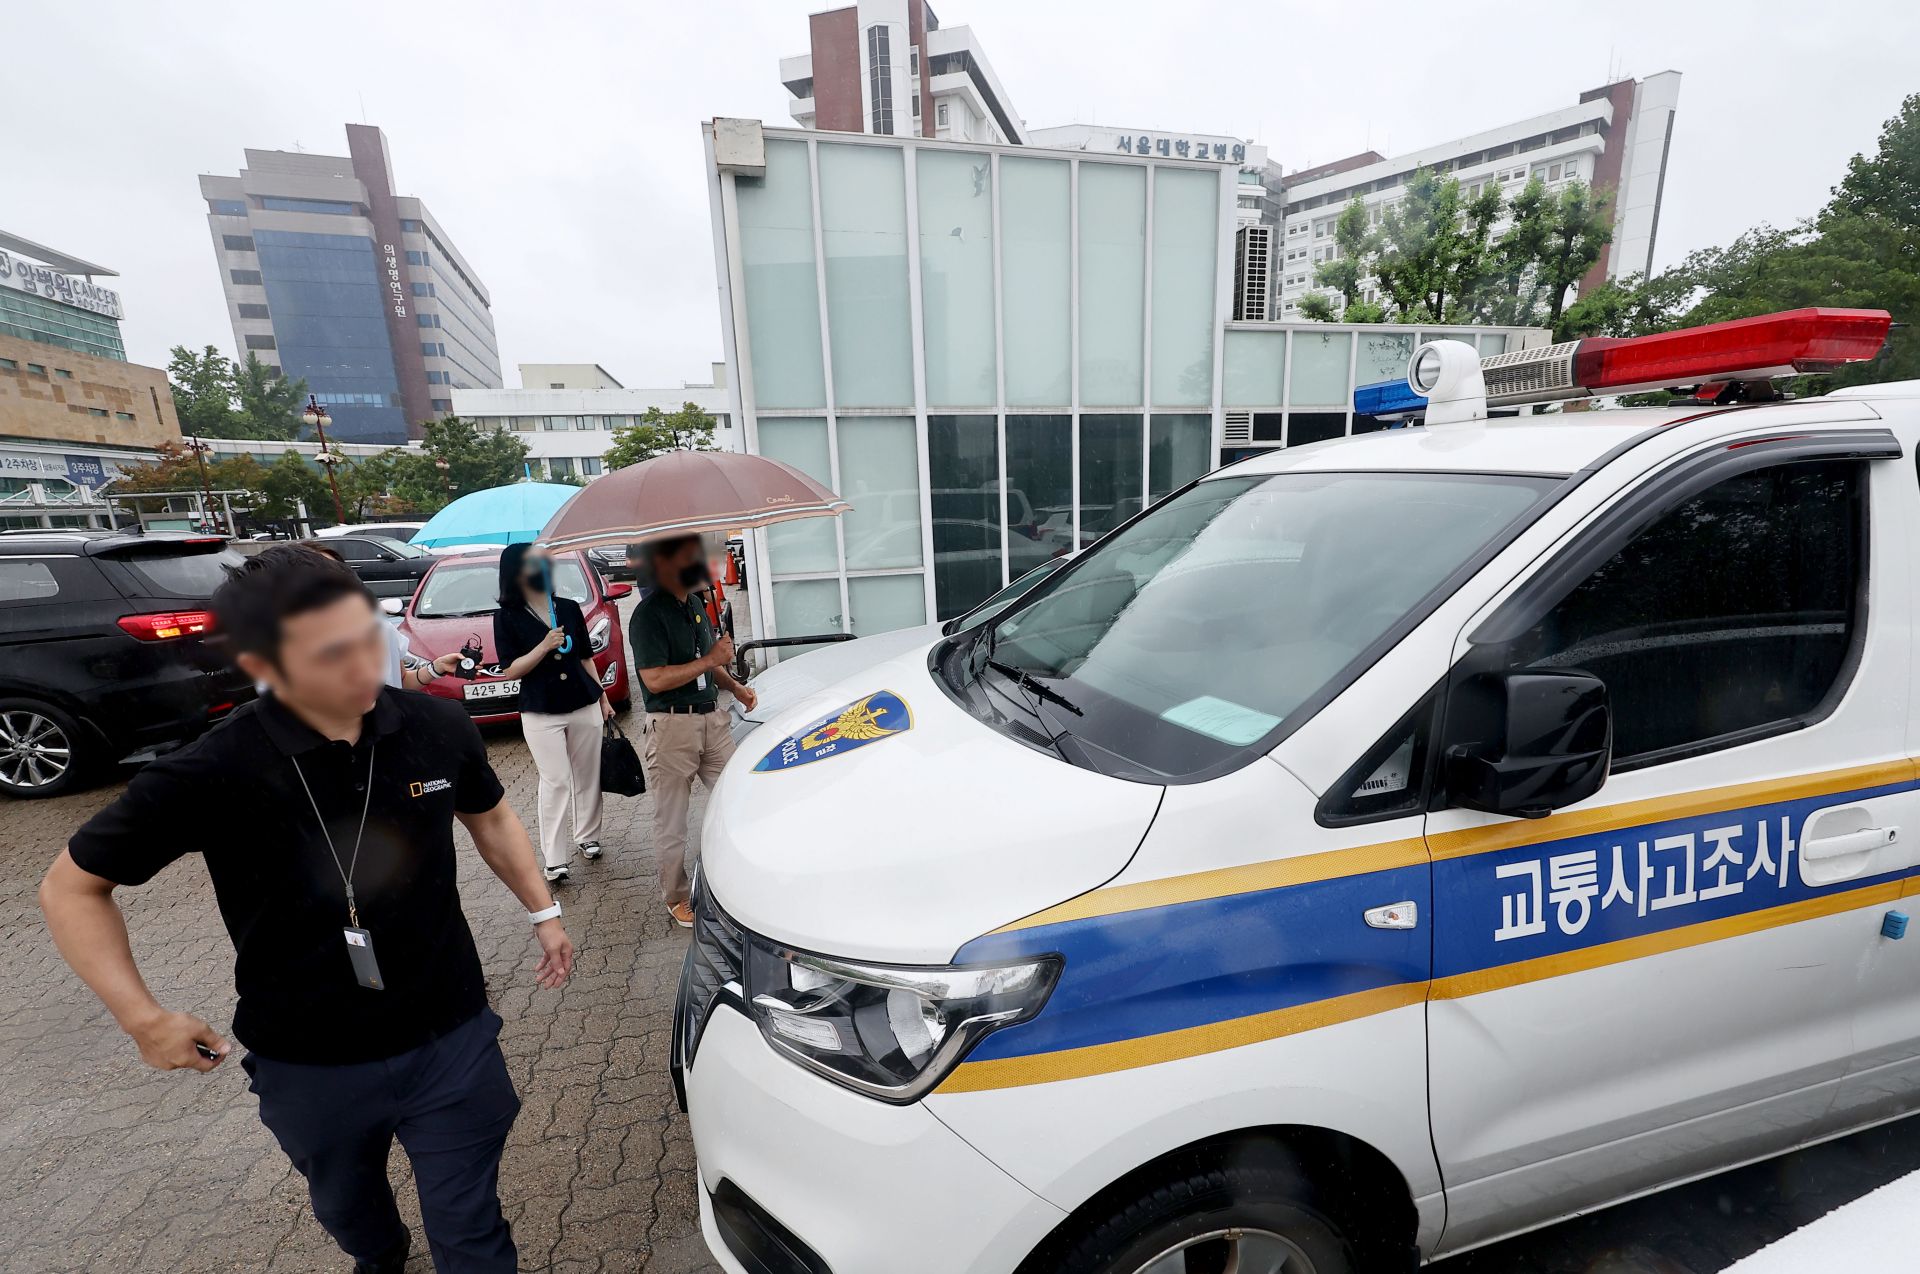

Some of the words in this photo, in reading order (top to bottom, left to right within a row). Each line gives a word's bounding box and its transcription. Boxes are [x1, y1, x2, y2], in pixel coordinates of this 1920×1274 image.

[1117, 135, 1246, 162] 서울대학교병원
[16, 262, 75, 305] 암병원
[72, 279, 119, 307] CANCER
[383, 244, 407, 318] 의생명연구원
[75, 295, 121, 318] HOSPITAL
[5, 458, 38, 471] 2주차장
[71, 462, 100, 475] 3주차장
[471, 684, 497, 697] 42무
[503, 681, 521, 694] 56
[781, 738, 799, 766] POLICE
[422, 778, 448, 788] NATIONAL
[423, 781, 452, 793] GEOGRAPHIC
[1494, 814, 1796, 943] 교통사고조사
